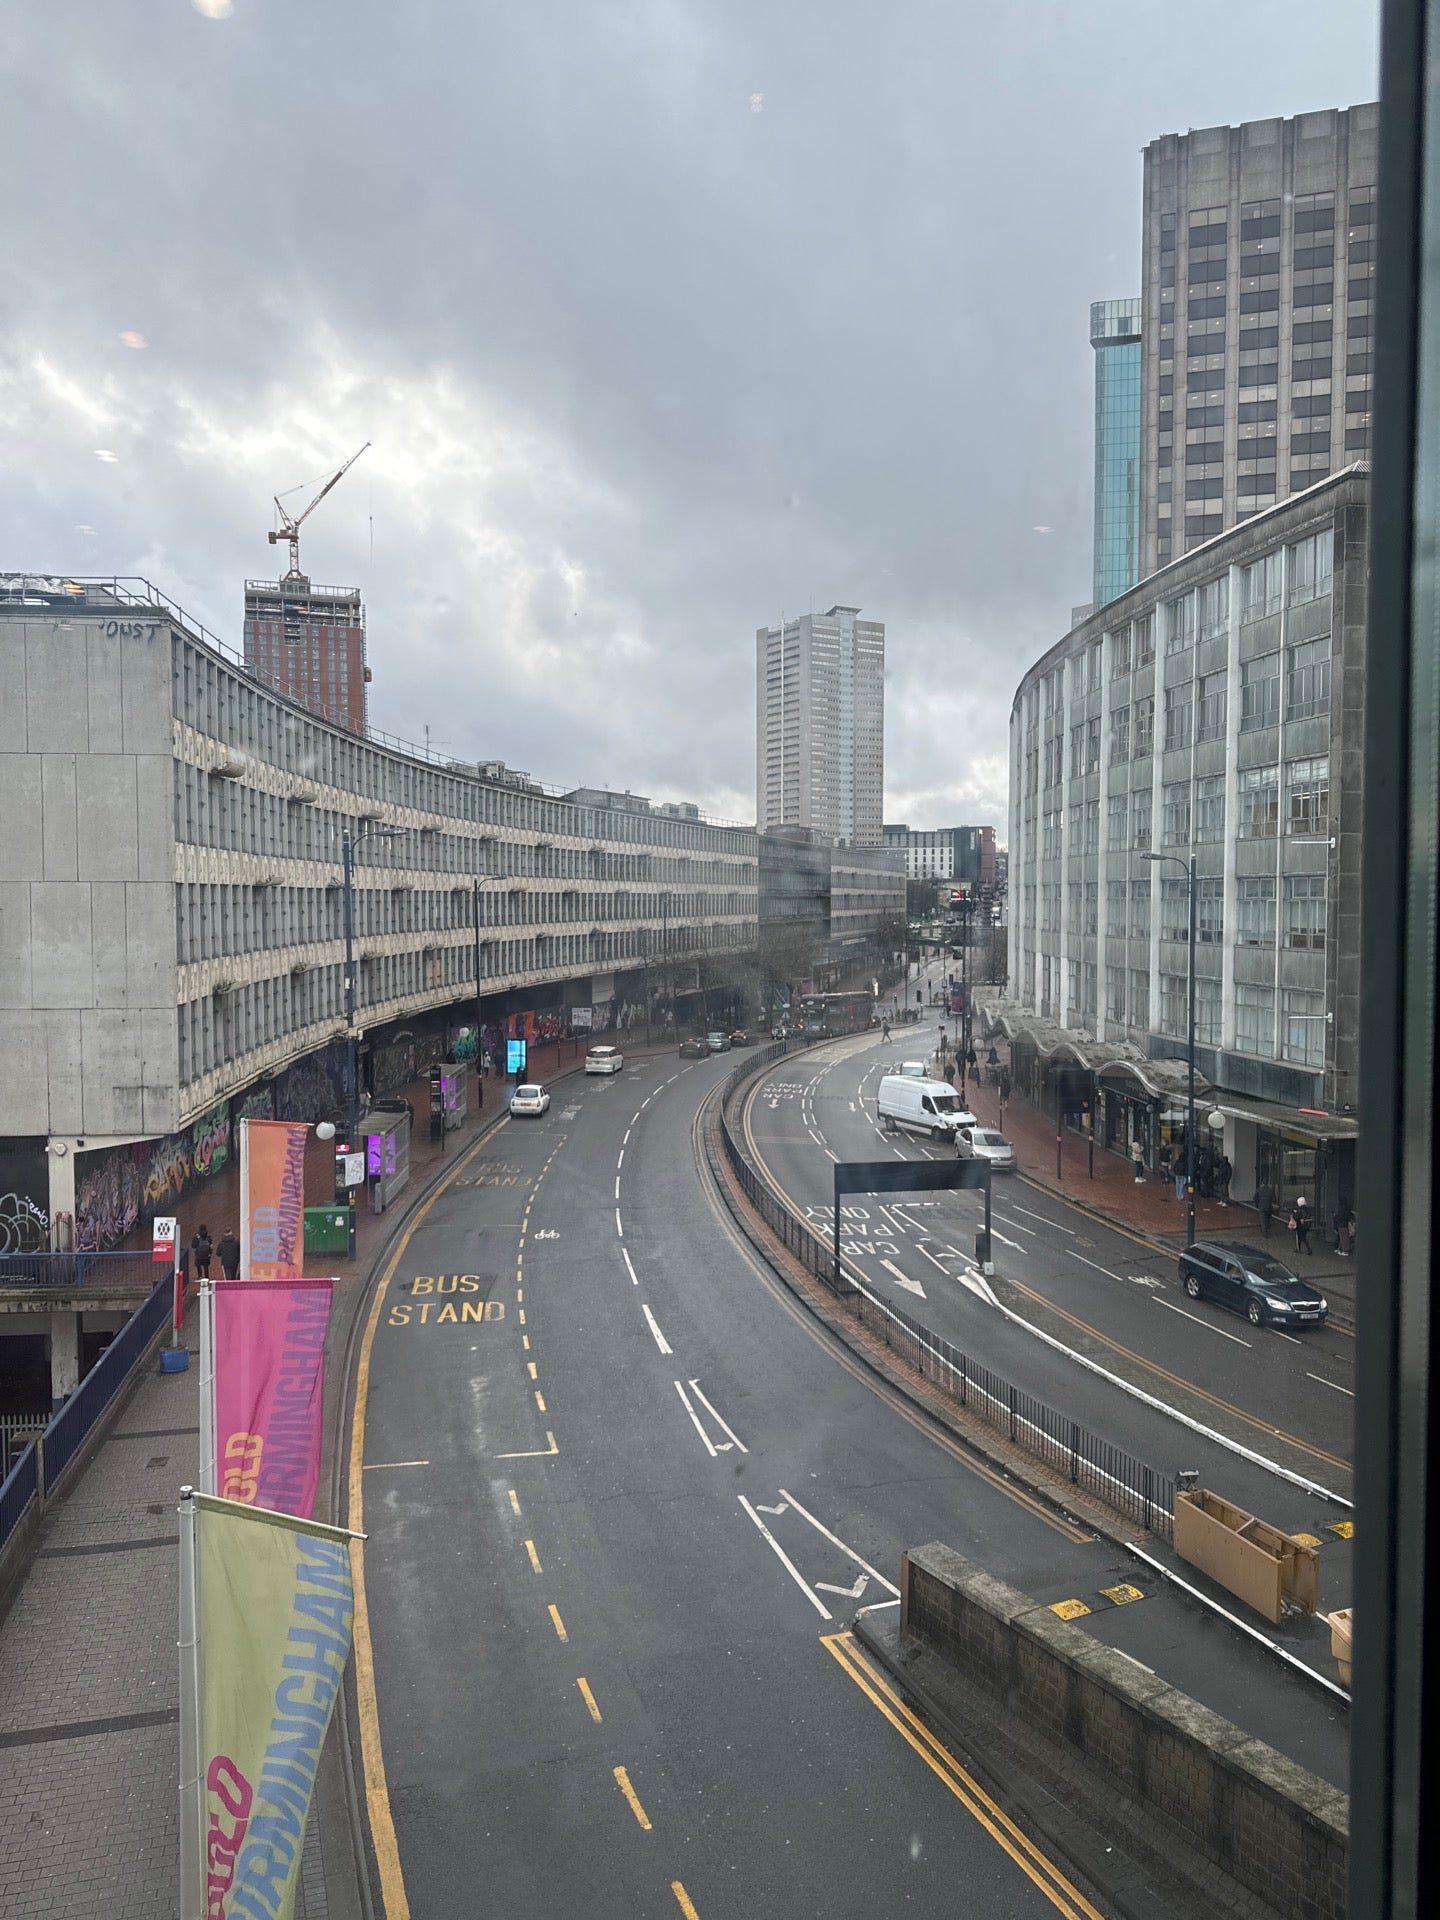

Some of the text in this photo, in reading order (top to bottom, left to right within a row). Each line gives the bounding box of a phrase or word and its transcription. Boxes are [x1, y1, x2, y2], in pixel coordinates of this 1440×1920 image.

[277, 1128, 308, 1266] BIRMINGHAM
[804, 1206, 871, 1219] ONLY
[251, 1205, 279, 1263] BOLD
[810, 1223, 895, 1236] PARK
[839, 1241, 901, 1255] CAR
[411, 1274, 480, 1295] BUS
[388, 1301, 506, 1326] STAND
[223, 1432, 264, 1505] OLD
[226, 1533, 354, 1920] IRMINGHAM
